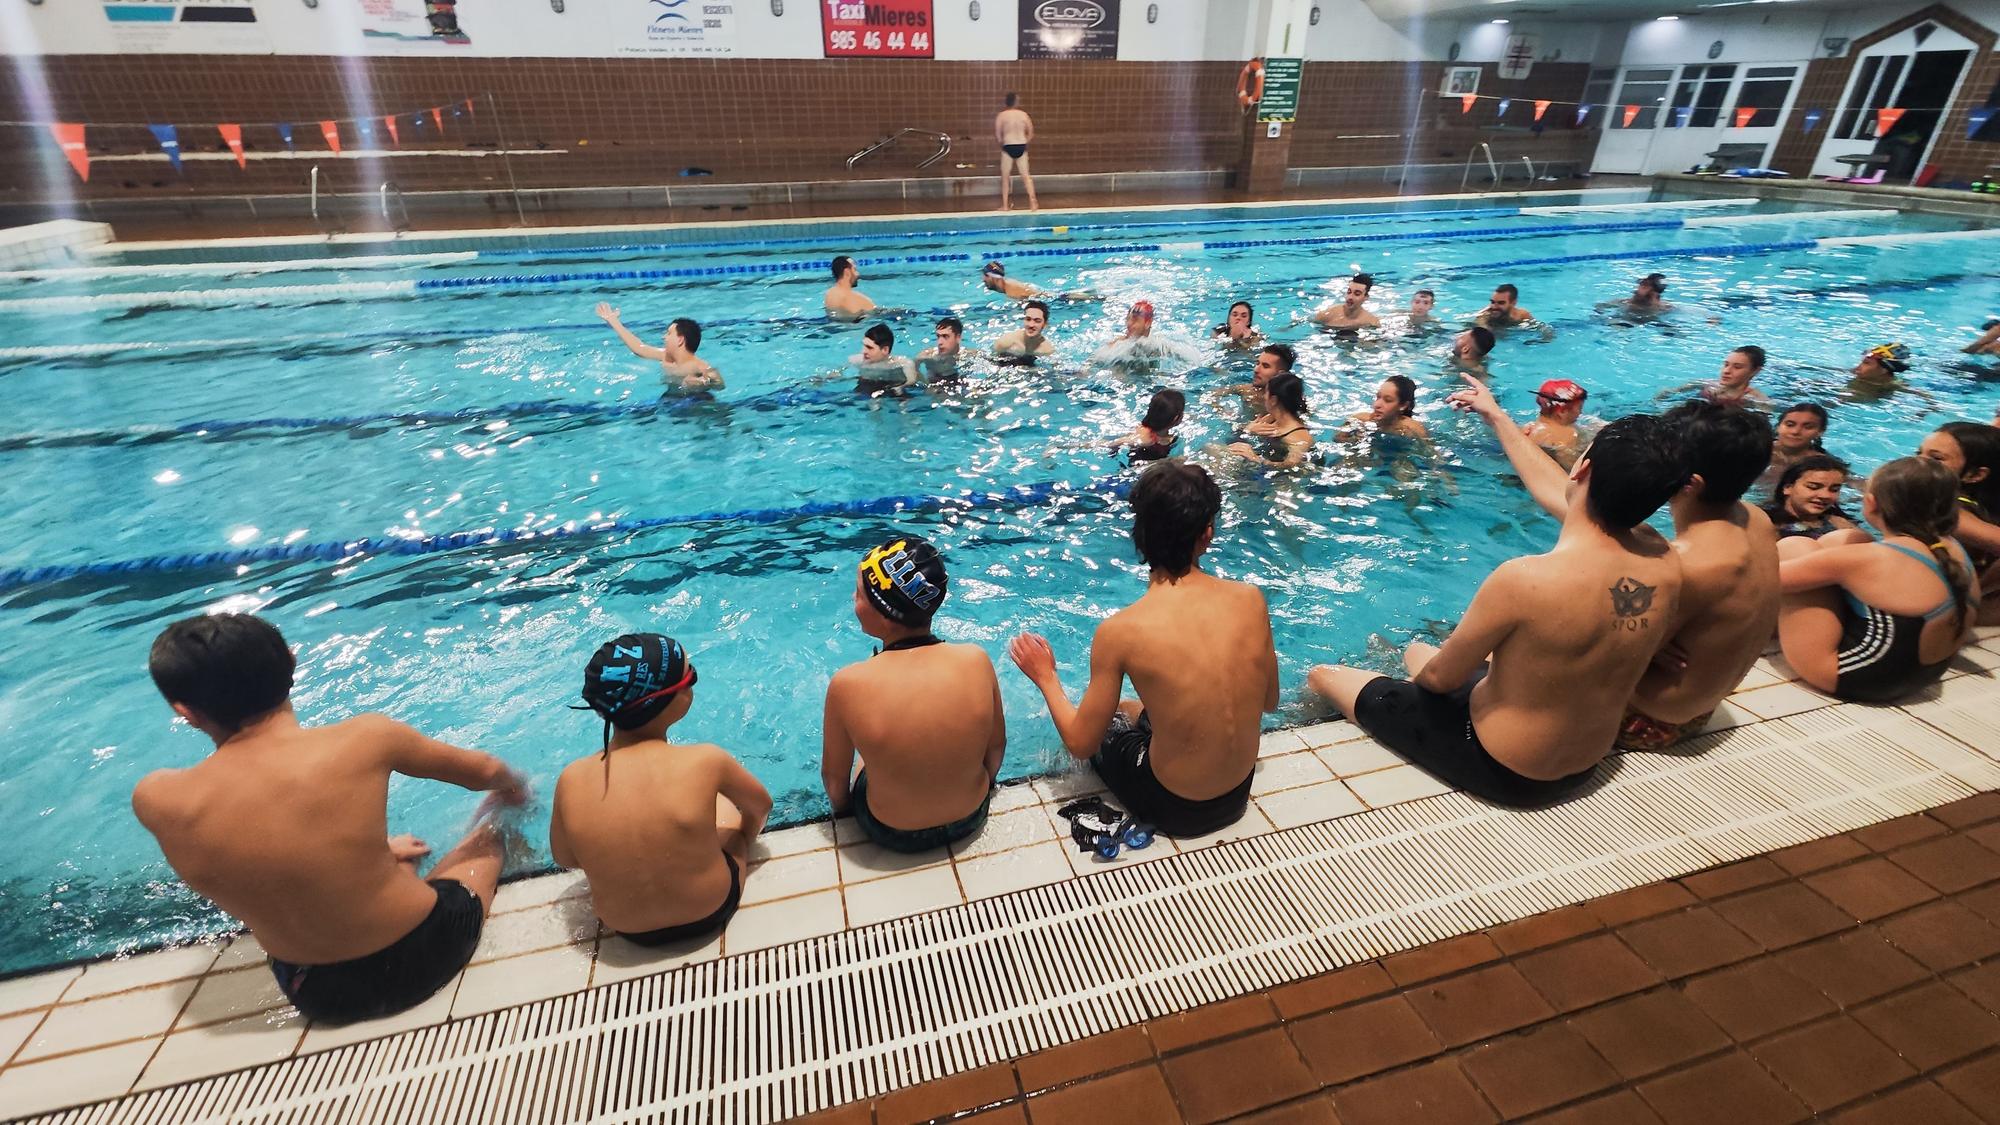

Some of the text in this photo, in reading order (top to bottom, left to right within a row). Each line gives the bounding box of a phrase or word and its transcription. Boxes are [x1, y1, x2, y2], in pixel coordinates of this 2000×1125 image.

[827, 0, 927, 26] Taxi Mieres
[830, 30, 929, 51] 985 46 44 44
[1611, 618, 1649, 632] SPQR
